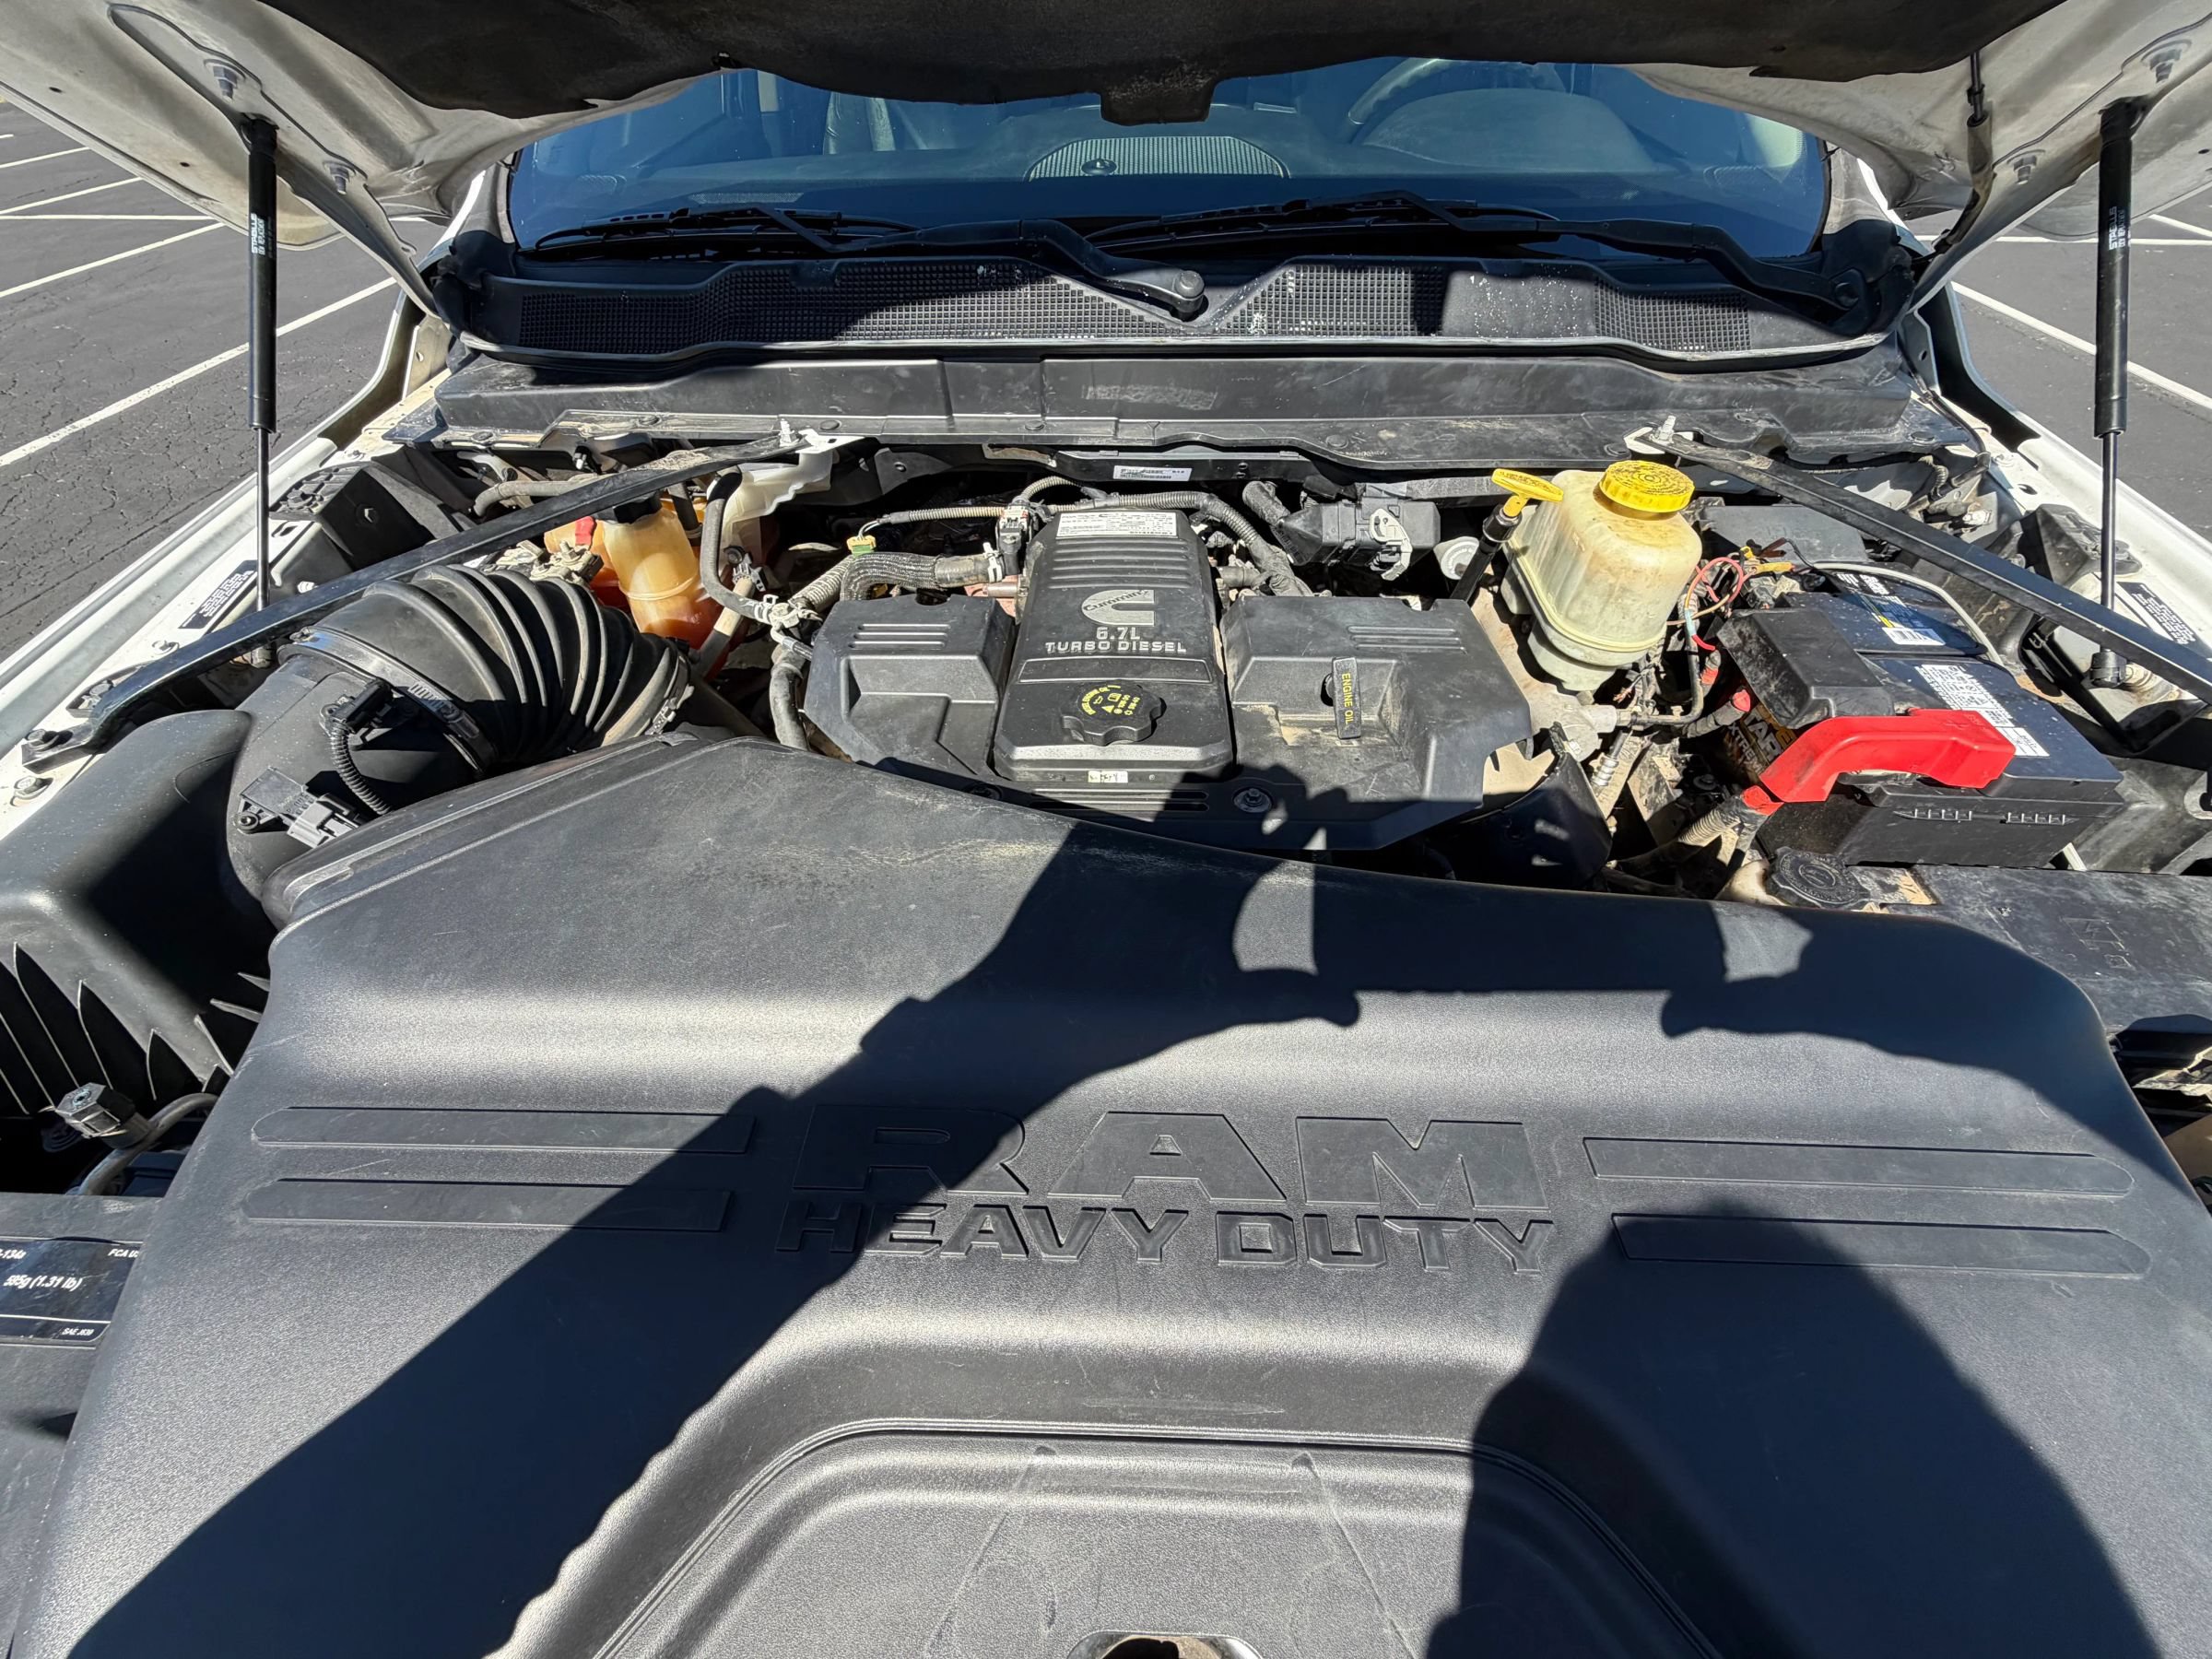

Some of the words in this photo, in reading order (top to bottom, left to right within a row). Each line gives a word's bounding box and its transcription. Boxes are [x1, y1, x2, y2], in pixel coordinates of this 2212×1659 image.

[1083, 589, 1148, 612] Cummins
[1096, 626, 1141, 640] 6.7L
[1044, 641, 1111, 653] TURBO
[1117, 641, 1187, 653] DIESEL
[1342, 673, 1353, 708] ENGINE
[1345, 710, 1354, 725] OIL
[1744, 707, 1783, 762] TAR
[792, 1106, 1550, 1212] RAM
[775, 1201, 1189, 1262] HEAVY
[1216, 1210, 1554, 1274] DUTY
[108, 1248, 128, 1257] FCA
[29, 1275, 64, 1288] (1.31
[61, 1277, 84, 1291] lb)
